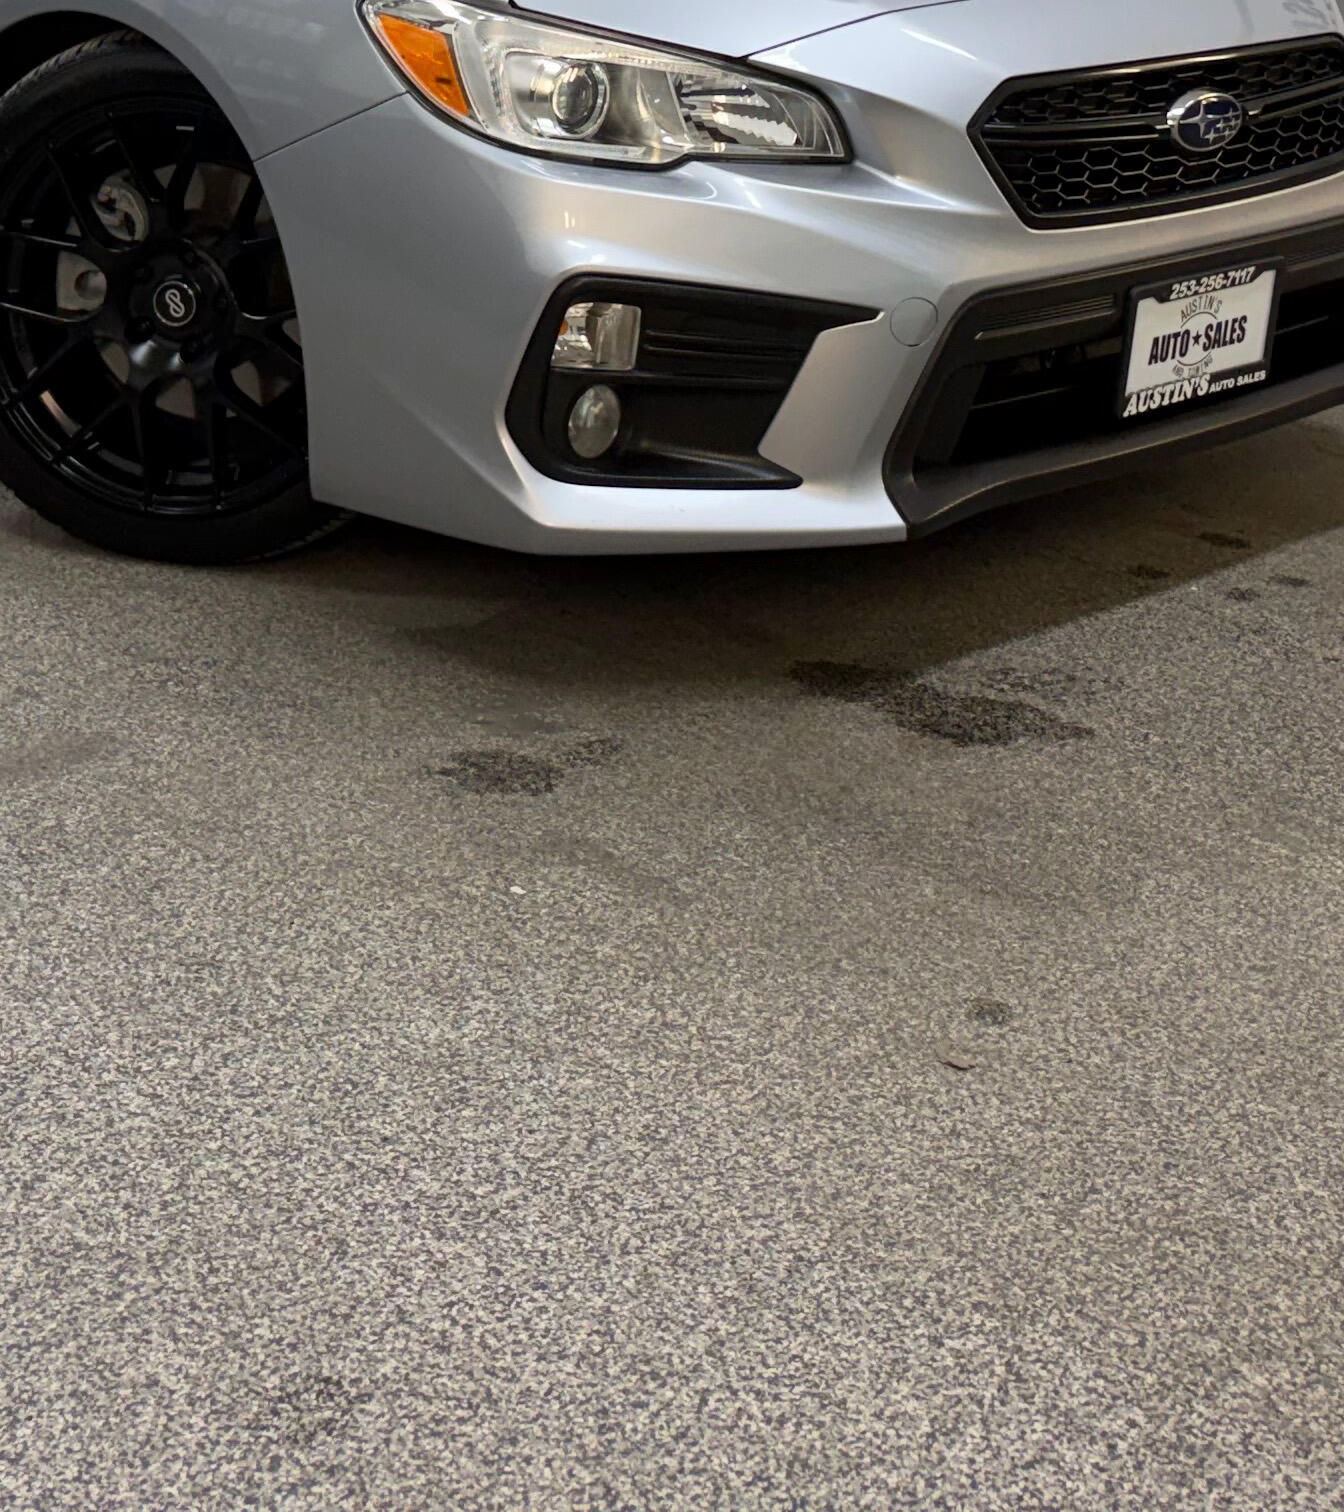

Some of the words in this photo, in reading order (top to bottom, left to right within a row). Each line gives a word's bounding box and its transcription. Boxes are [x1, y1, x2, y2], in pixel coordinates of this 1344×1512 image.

[1169, 266, 1256, 300] 253-256-7117
[1179, 293, 1224, 323] AUSTIN'S
[1147, 329, 1192, 366] AUTO
[1202, 315, 1248, 352] SALES
[1122, 374, 1211, 418] AUSTIN'S
[1209, 377, 1236, 393] AUTO
[1236, 370, 1267, 388] SALES
